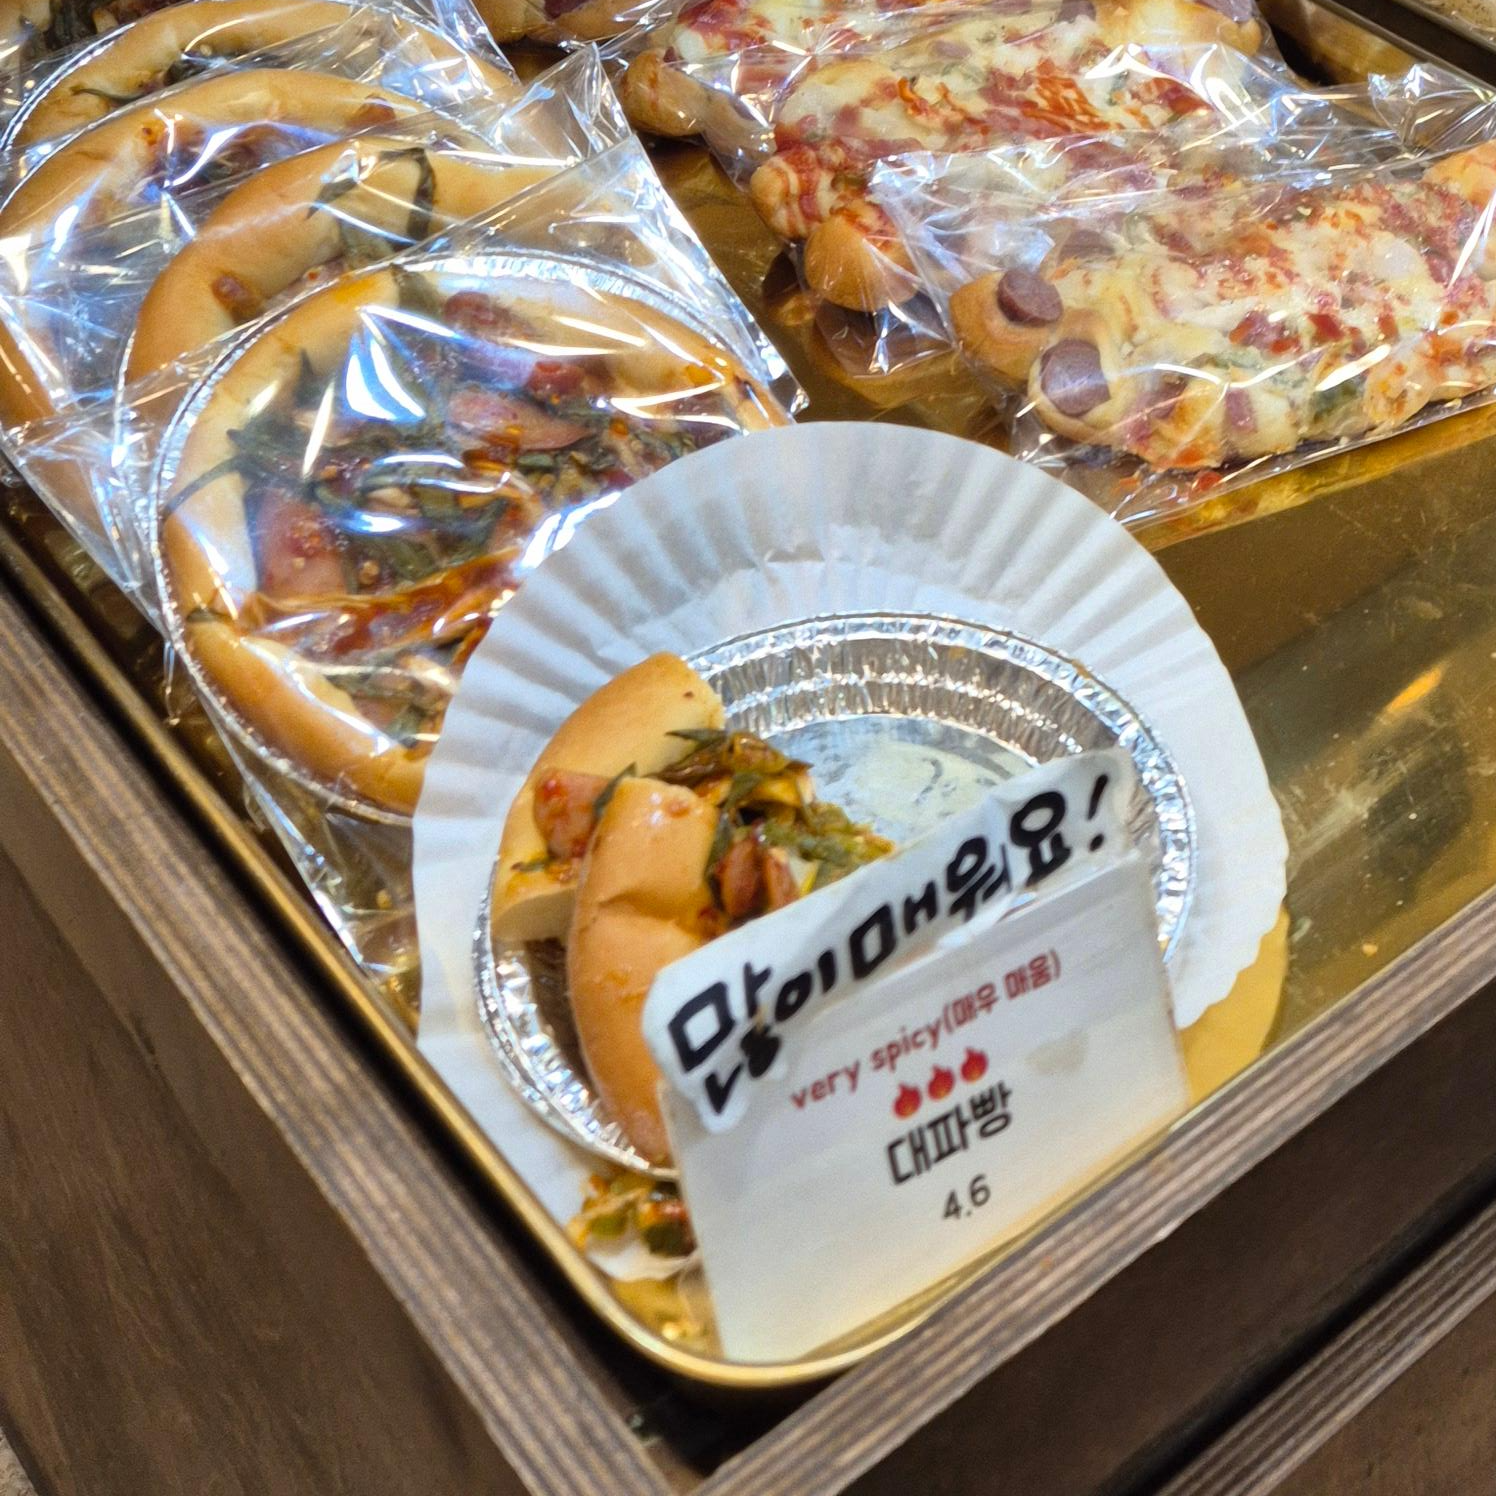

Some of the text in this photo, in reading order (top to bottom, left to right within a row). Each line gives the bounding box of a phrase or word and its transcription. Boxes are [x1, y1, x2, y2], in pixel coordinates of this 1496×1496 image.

[791, 1060, 860, 1109] very
[886, 1080, 1012, 1186] 대파빵
[942, 1173, 991, 1220] 4.6
